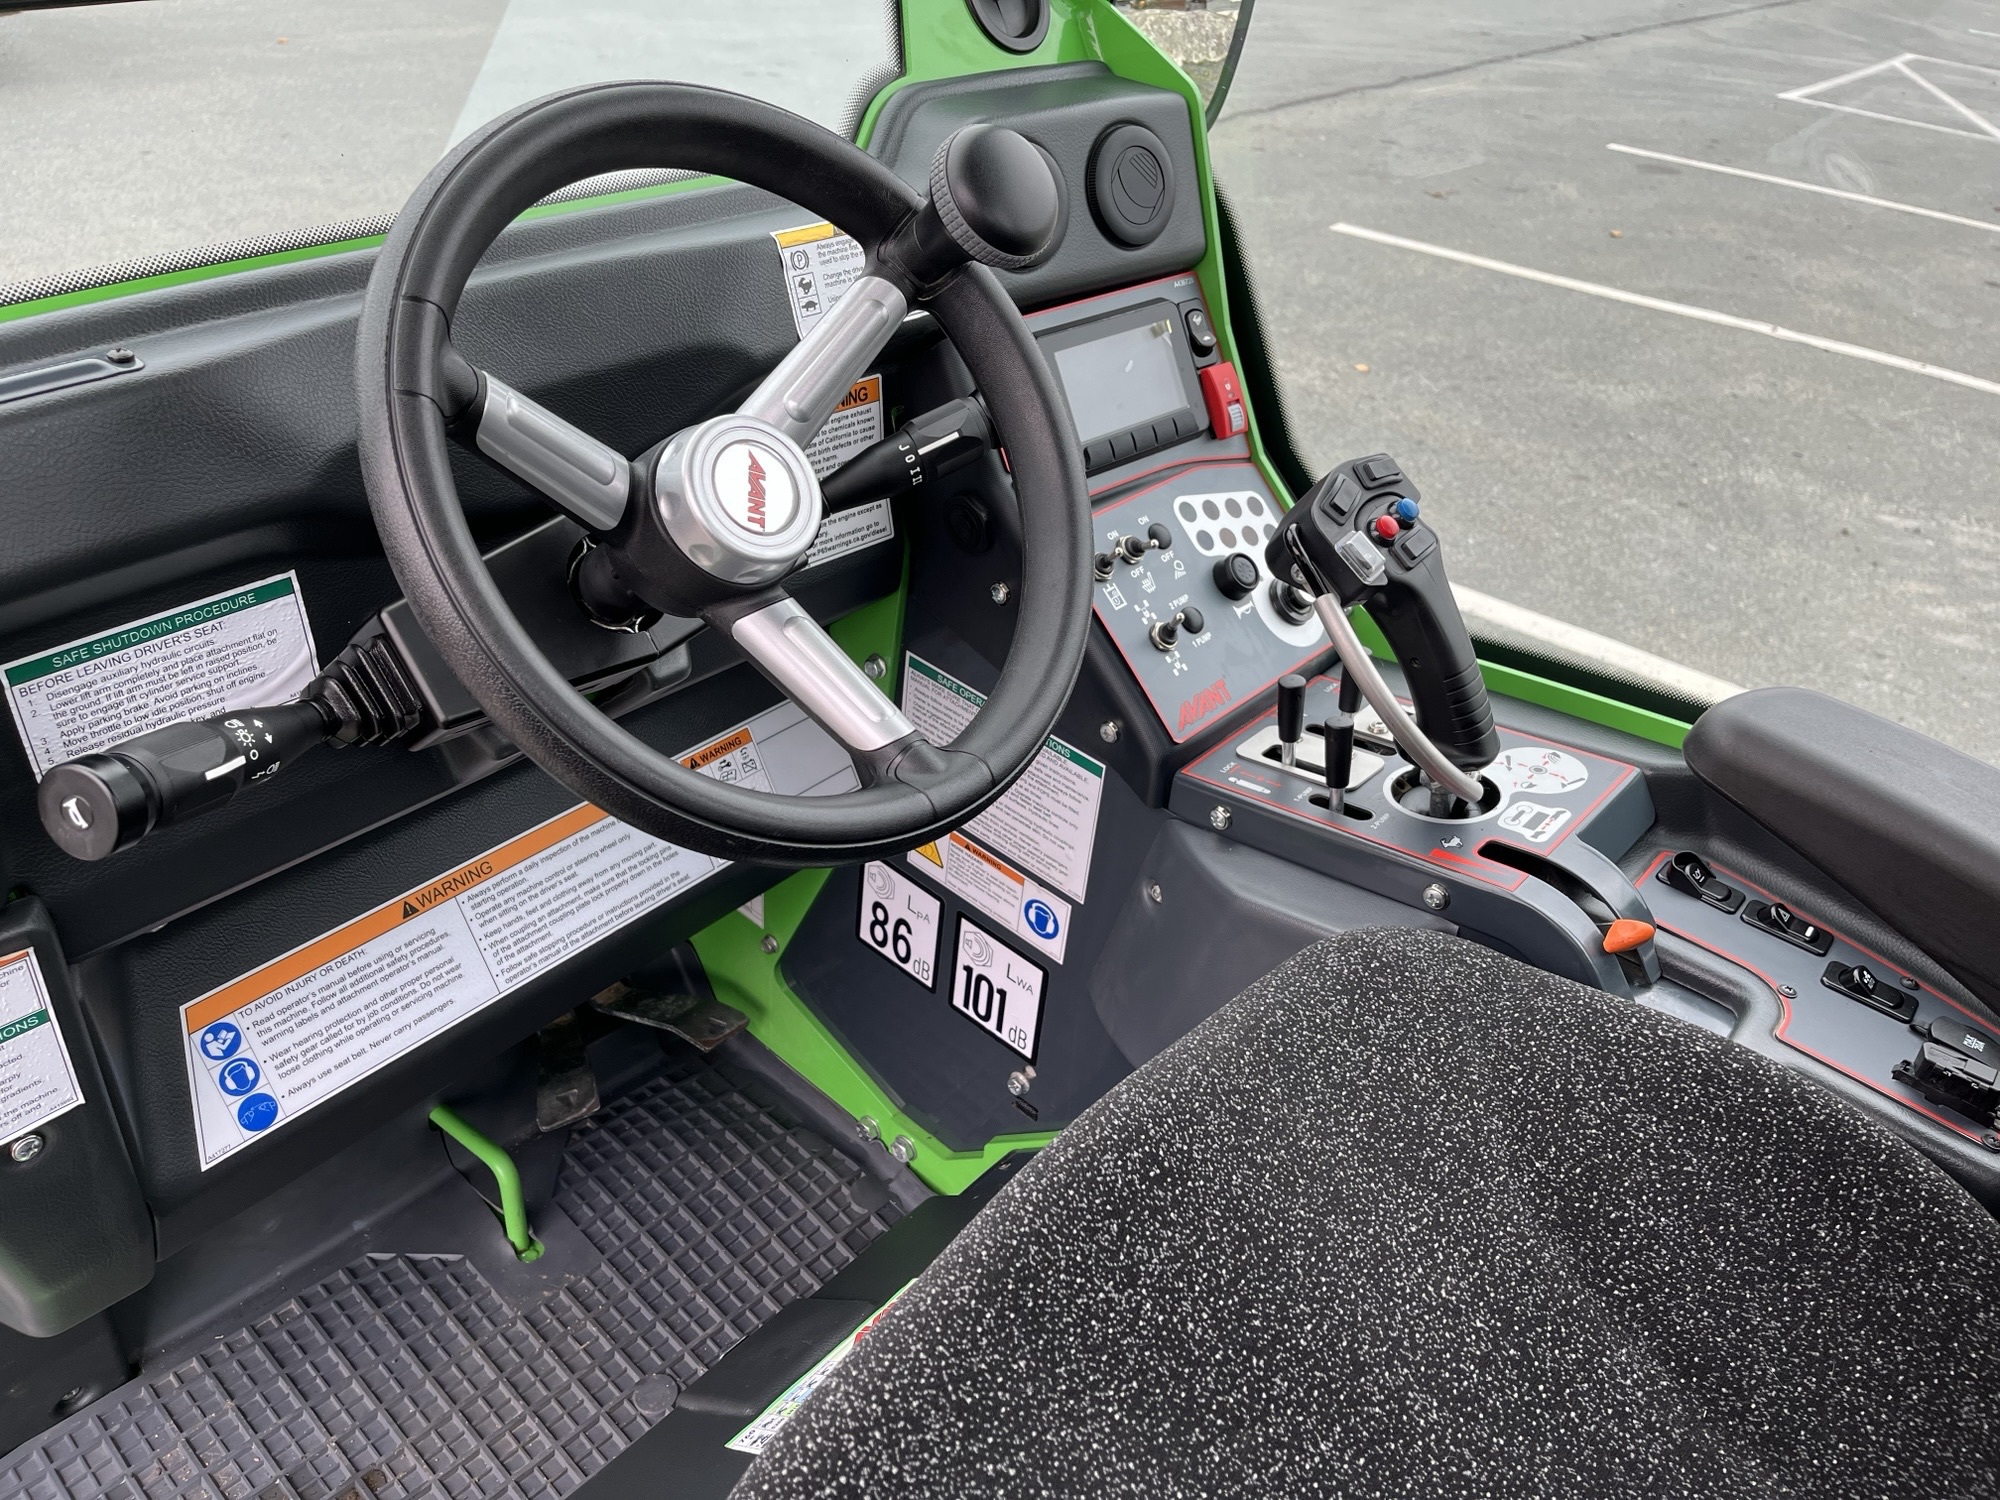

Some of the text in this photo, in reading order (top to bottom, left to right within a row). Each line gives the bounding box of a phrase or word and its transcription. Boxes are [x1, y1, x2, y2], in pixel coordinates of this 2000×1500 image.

[827, 421, 855, 434] chemicals
[856, 416, 874, 425] known
[830, 407, 871, 424] engine exhaust
[817, 438, 824, 446] of
[824, 431, 851, 444] California
[859, 424, 875, 434] cause
[748, 449, 766, 528] AVANT
[1138, 515, 1150, 525] ON
[818, 537, 833, 546] more
[833, 526, 864, 540] information
[1106, 530, 1119, 540] ON
[1160, 550, 1175, 563] OFF
[1130, 566, 1145, 578] OFF
[1173, 594, 1189, 606] PUMP
[52, 592, 256, 667] SAFE SHUTDOWN PROCEDURE
[1197, 632, 1212, 645] PUMP
[18, 671, 74, 697] BEFORE
[75, 652, 131, 678] LEAVING
[133, 631, 191, 658] DRIVER'S
[45, 678, 98, 701] Disengage
[100, 664, 138, 683] auxiliary
[140, 650, 182, 669] hydraulic
[49, 696, 78, 711] Lower
[78, 690, 92, 701] lift
[90, 685, 111, 696] arm
[112, 668, 160, 689] completely
[162, 660, 179, 672] and
[179, 652, 204, 668] place
[205, 636, 252, 657] attachment
[252, 631, 265, 641] flat
[266, 628, 277, 636] on
[937, 674, 958, 692] SAFE
[59, 724, 85, 738] Apply
[87, 711, 122, 730] parking
[153, 690, 178, 705] Avoid
[179, 679, 212, 697] parking
[213, 675, 224, 684] on
[1178, 678, 1232, 732] AVANT
[65, 740, 105, 758] Release
[106, 724, 143, 743] residual
[144, 710, 186, 729] hydraulic
[700, 736, 742, 764] WARNING
[1220, 761, 1236, 774] LOCK
[972, 847, 1002, 870] WARNING
[416, 862, 492, 908] WARNING
[470, 894, 496, 910] starting
[478, 914, 497, 928] when
[497, 903, 518, 918] sitting
[518, 898, 527, 907] on
[527, 892, 539, 901] the
[539, 879, 563, 895] driver's
[870, 901, 912, 964] 86
[251, 928, 436, 1028] Read operator's manual before using or servicing
[913, 958, 930, 981] dB
[237, 1007, 252, 1018] TO
[254, 991, 283, 1012] AVOID
[283, 972, 316, 995] INJURY
[318, 964, 334, 976] OR
[261, 1025, 294, 1046] warning
[293, 1012, 319, 1028] labels
[319, 1001, 335, 1015] and
[336, 978, 378, 1006] attachment
[379, 959, 416, 982] operator's
[962, 964, 1007, 1034] 101
[268, 955, 454, 1061] Wear hearing protection and other proper personal
[1008, 1026, 1027, 1050] dB
[287, 1077, 316, 1096] Always
[317, 1067, 332, 1079] use
[333, 1056, 351, 1070] seat
[368, 1033, 391, 1049] Never
[393, 1022, 411, 1036] carry
[25, 1104, 42, 1116] and
